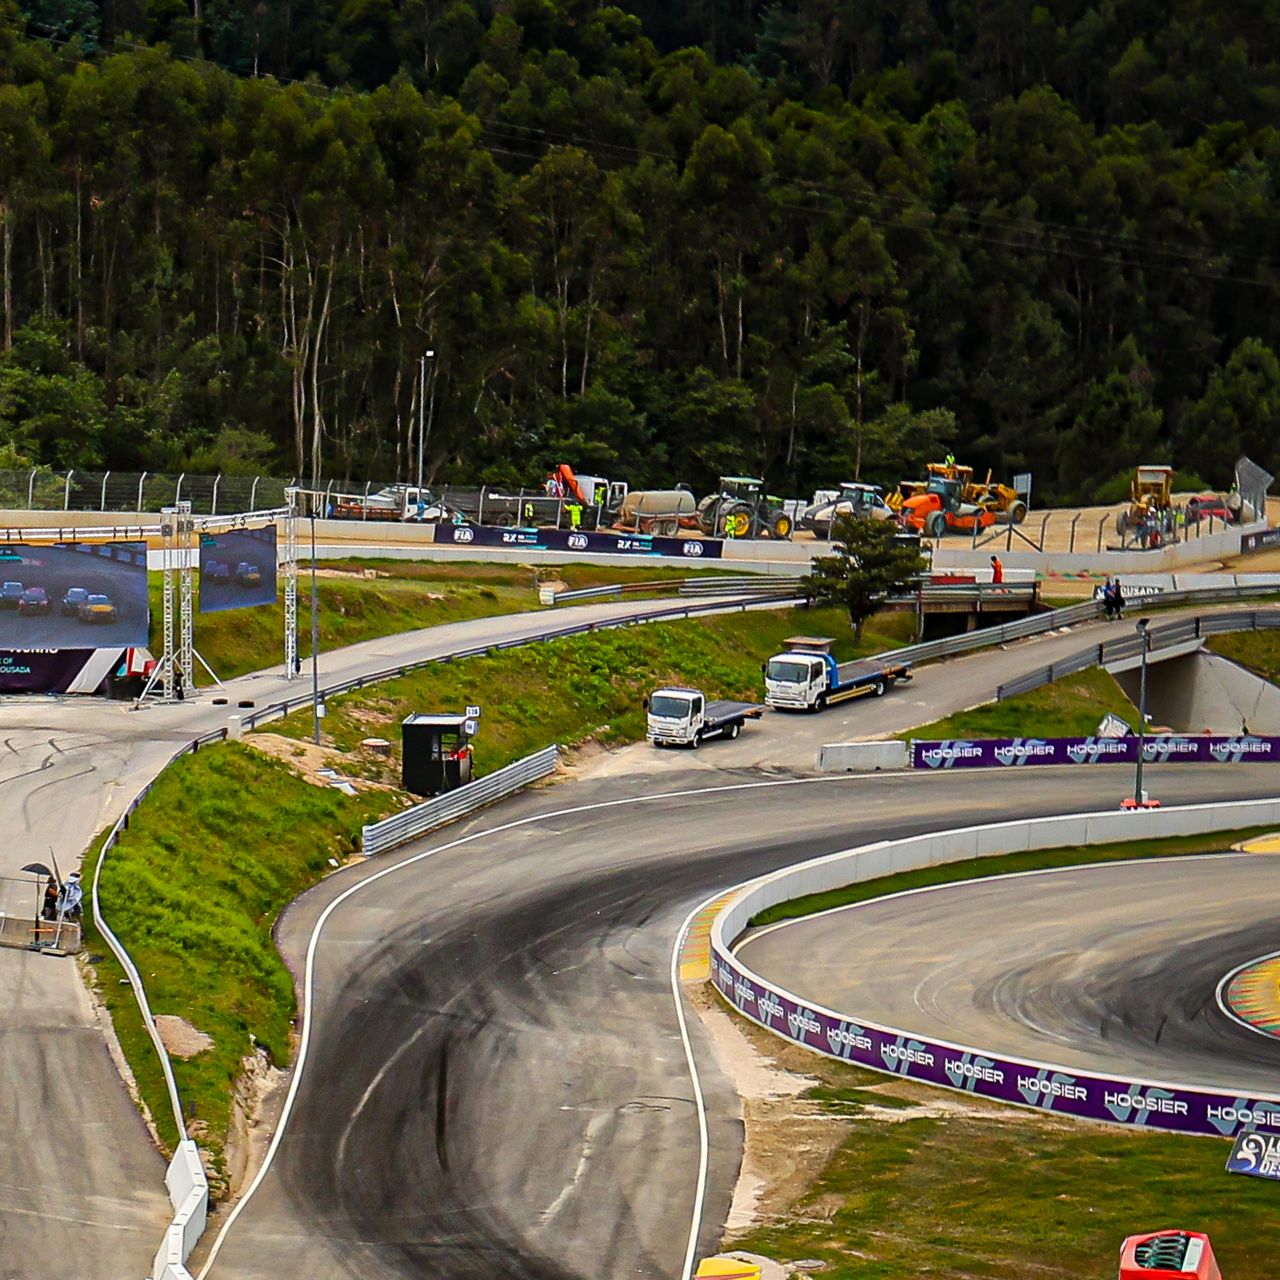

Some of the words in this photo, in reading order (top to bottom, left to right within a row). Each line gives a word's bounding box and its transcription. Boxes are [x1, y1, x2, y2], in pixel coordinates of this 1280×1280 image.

[503, 533, 516, 543] RX
[617, 539, 631, 549] RX
[922, 746, 983, 760] HOOSIER
[994, 745, 1055, 758] HOOSIER
[1066, 743, 1128, 756] HOOSIER
[1209, 742, 1272, 753] HOOSIER
[788, 1011, 821, 1035] HOOSIER
[827, 1027, 873, 1051] HOOSIER
[880, 1043, 935, 1068] HOOSIER
[944, 1058, 1004, 1085] HOOSIER
[1016, 1074, 1088, 1101] HOOSIER
[1103, 1090, 1189, 1116] HOOSIER
[1206, 1103, 1280, 1127] HOOSIE
